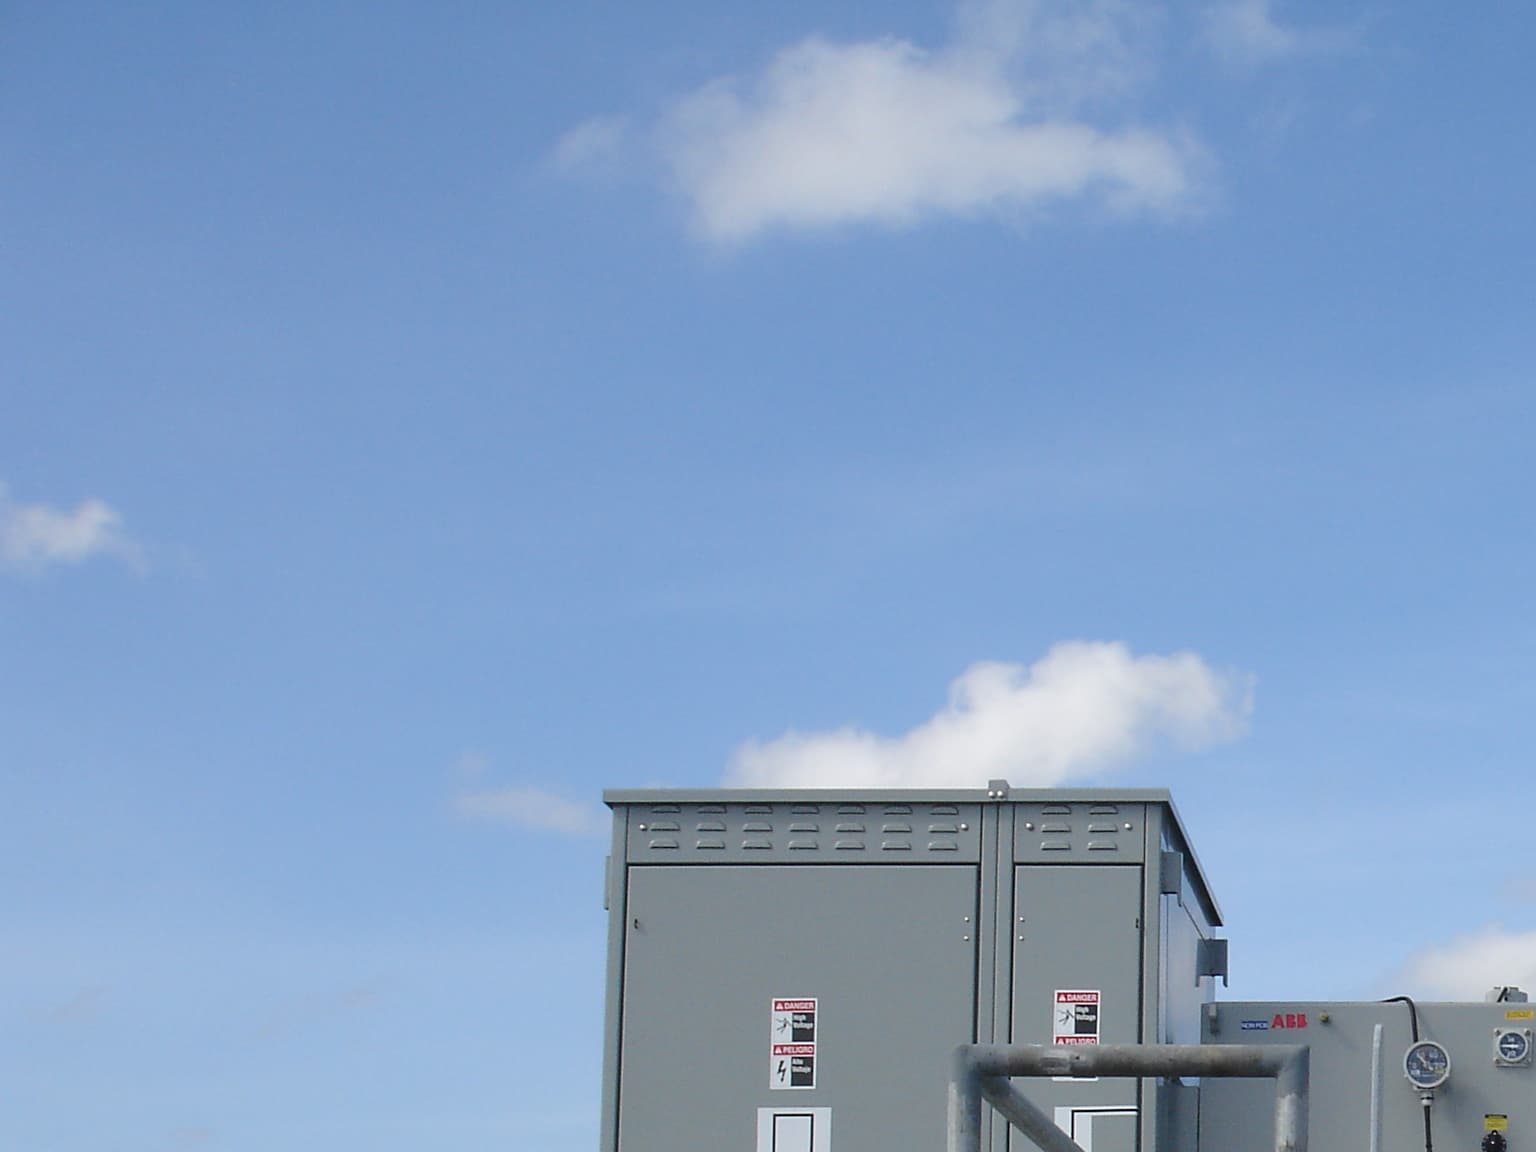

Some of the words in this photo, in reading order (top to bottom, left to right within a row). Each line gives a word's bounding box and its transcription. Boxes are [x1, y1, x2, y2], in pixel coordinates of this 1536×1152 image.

[1067, 993, 1097, 1001] DANGER
[784, 1002, 814, 1010] DANGER
[1272, 1013, 1308, 1028] ABB
[783, 1046, 813, 1054] PELIGRO
